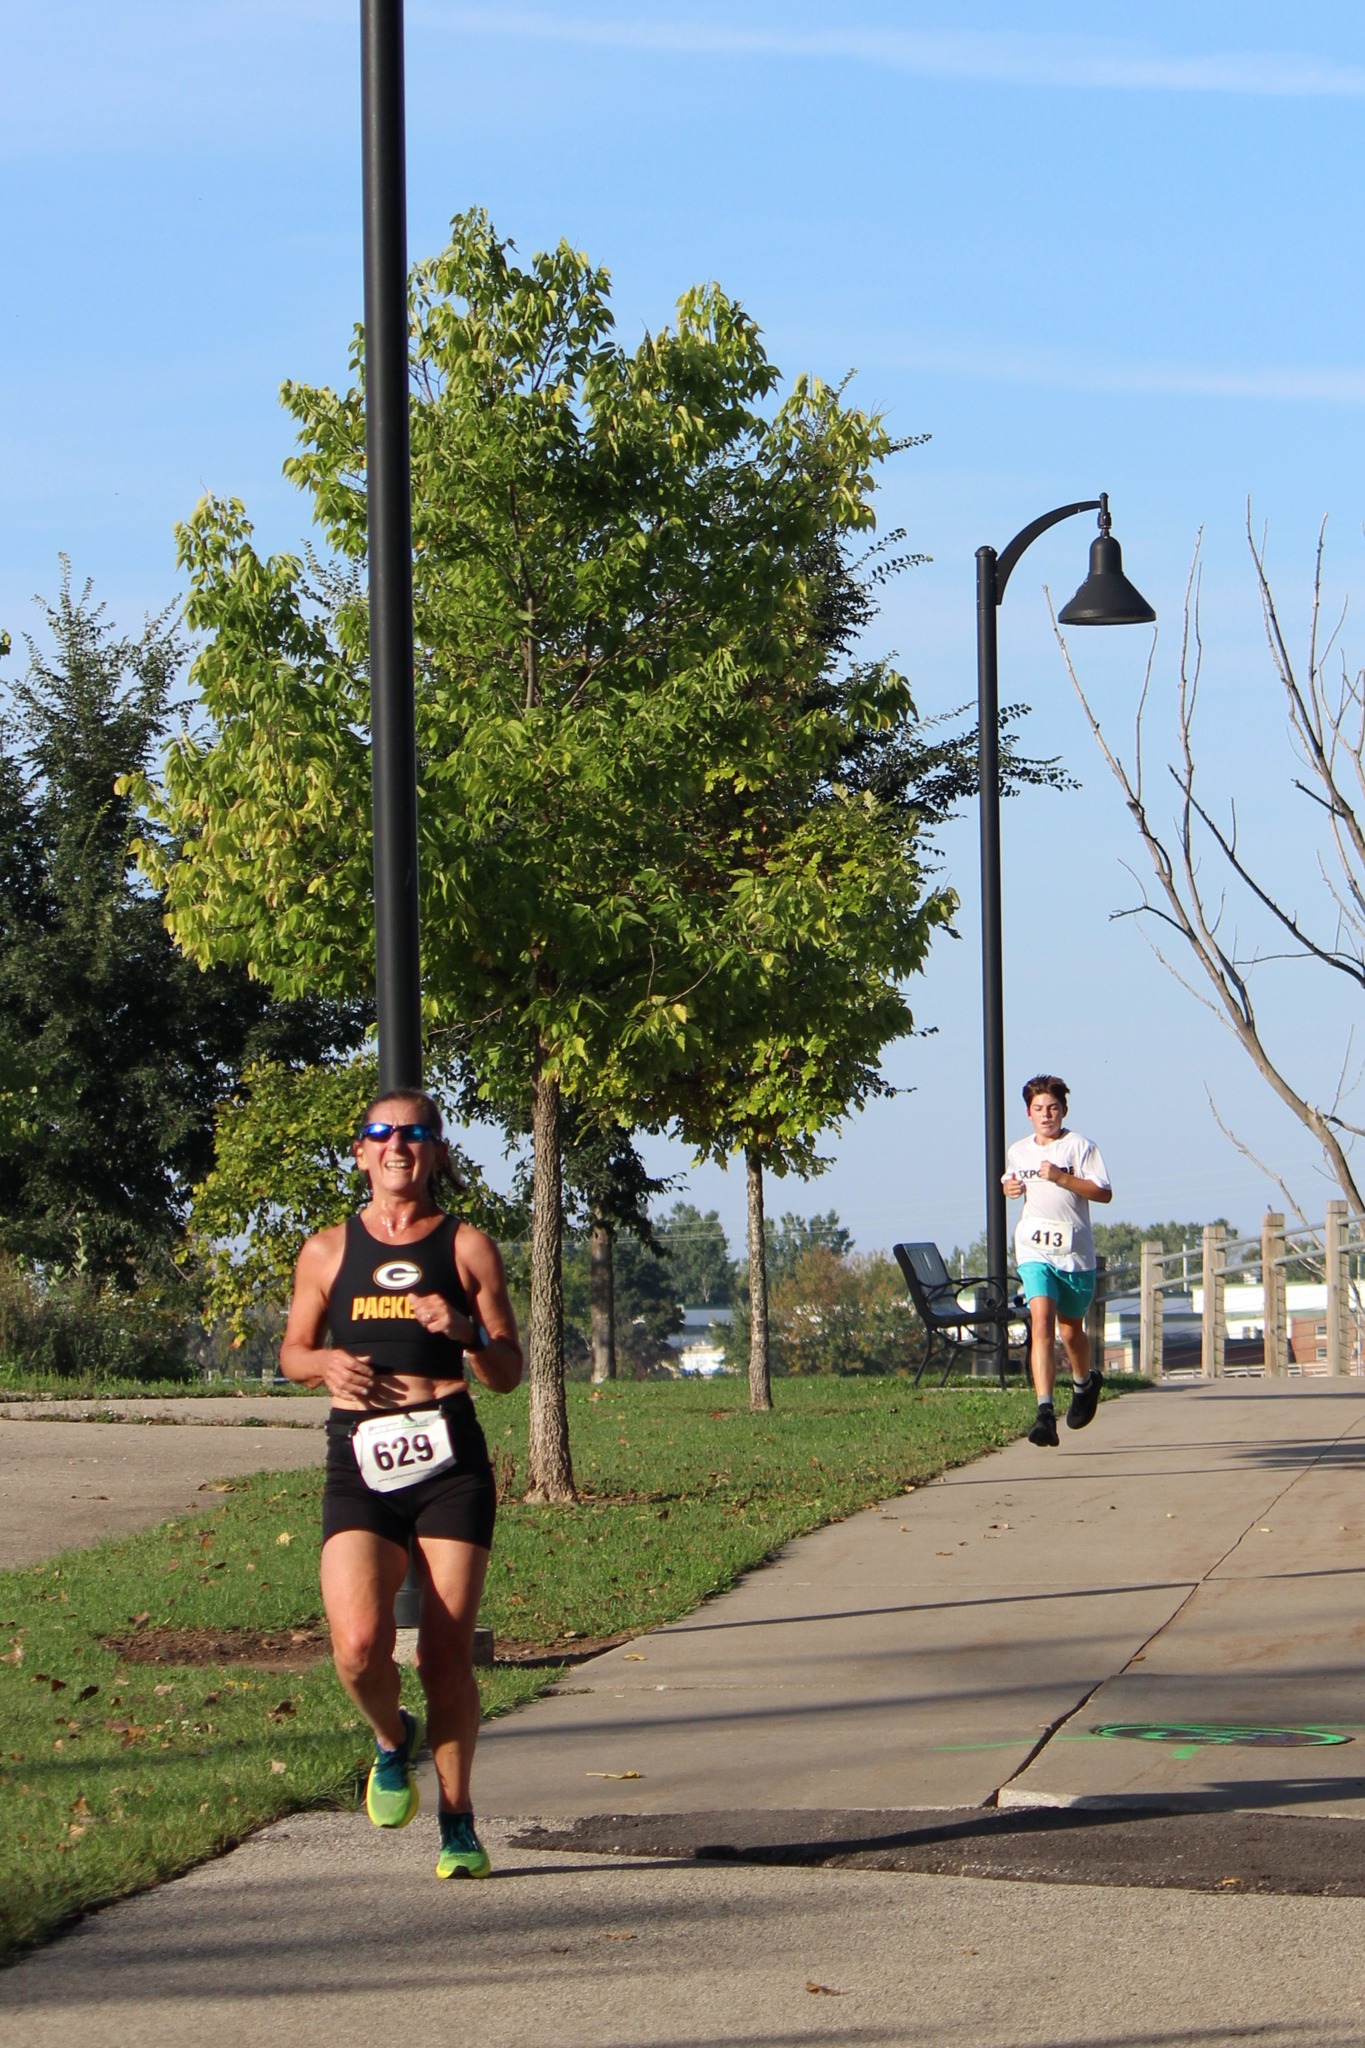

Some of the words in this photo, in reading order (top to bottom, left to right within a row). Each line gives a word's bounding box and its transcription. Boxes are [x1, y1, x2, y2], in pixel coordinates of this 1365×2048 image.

[1031, 1229, 1063, 1247] 413
[374, 1261, 421, 1290] G
[351, 1296, 416, 1321] PACKE
[372, 1434, 434, 1471] 629
